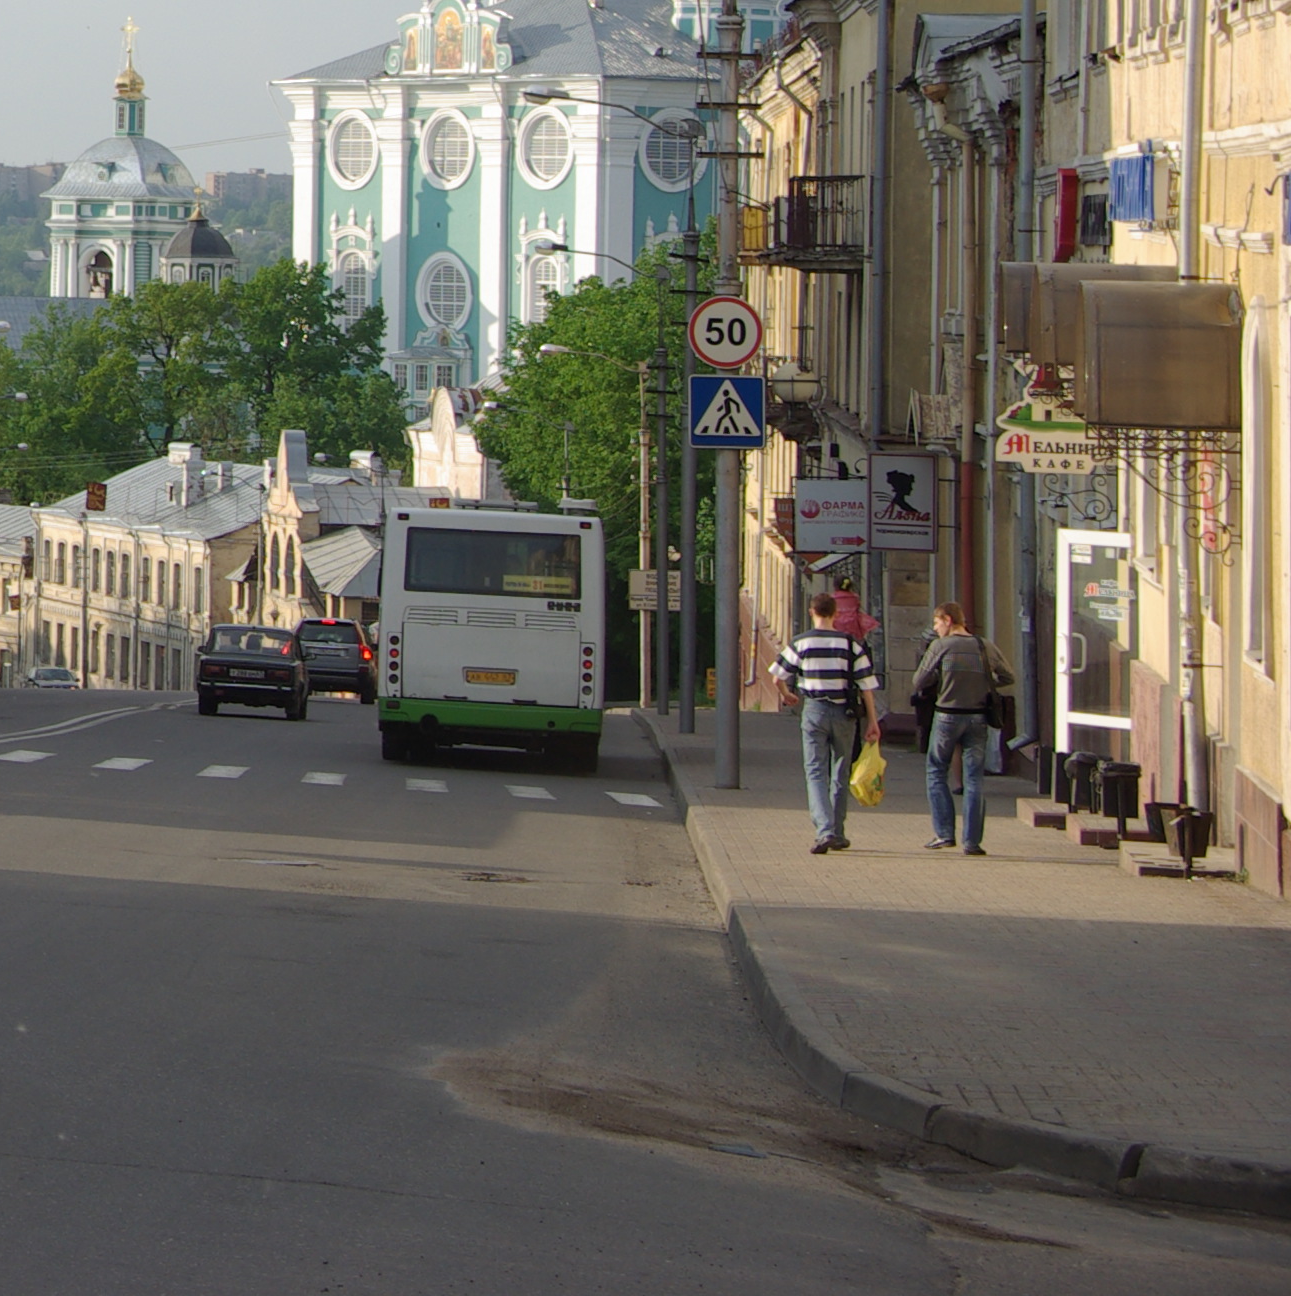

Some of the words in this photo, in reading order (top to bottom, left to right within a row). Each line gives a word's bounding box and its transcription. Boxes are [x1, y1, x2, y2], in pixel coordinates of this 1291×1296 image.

[705, 317, 747, 346] 50
[1032, 457, 1085, 470] КАФЕ
[821, 500, 865, 510] ФАРМА
[821, 510, 865, 518] ГРАФИКС
